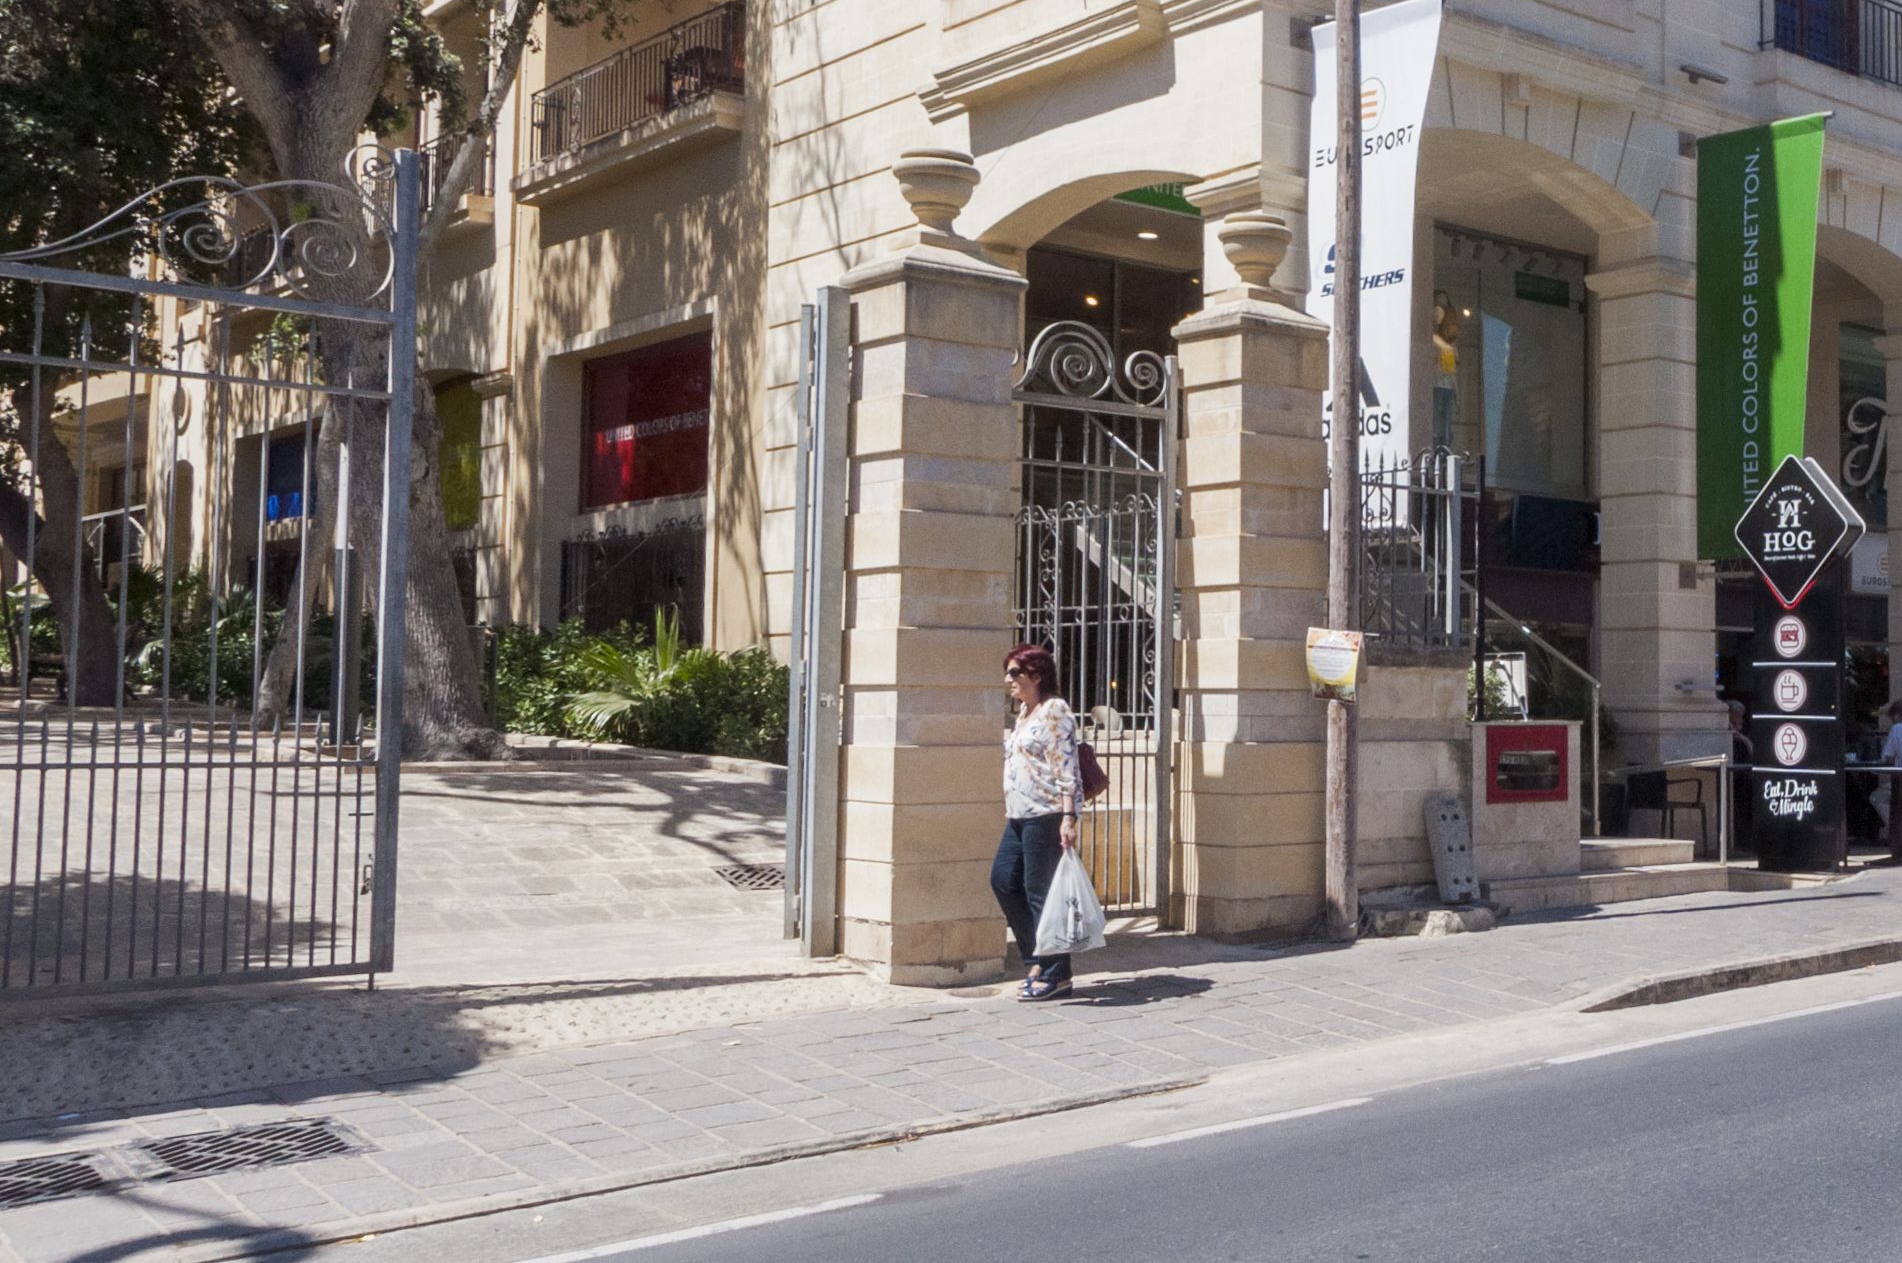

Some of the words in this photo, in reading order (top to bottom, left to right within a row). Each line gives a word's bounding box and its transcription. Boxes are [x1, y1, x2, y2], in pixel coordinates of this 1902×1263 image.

[1315, 124, 1414, 168] EUSPORT
[1743, 146, 1761, 287] BENETTON.
[1320, 268, 1405, 298] SHERS
[1743, 294, 1759, 328] OF
[1743, 332, 1759, 434] COLORS
[1322, 408, 1392, 439] adas
[1743, 441, 1760, 503] ITED
[1763, 780, 1784, 799] Eat,
[1784, 779, 1818, 797] Drink
[1778, 795, 1815, 821] Mingle
